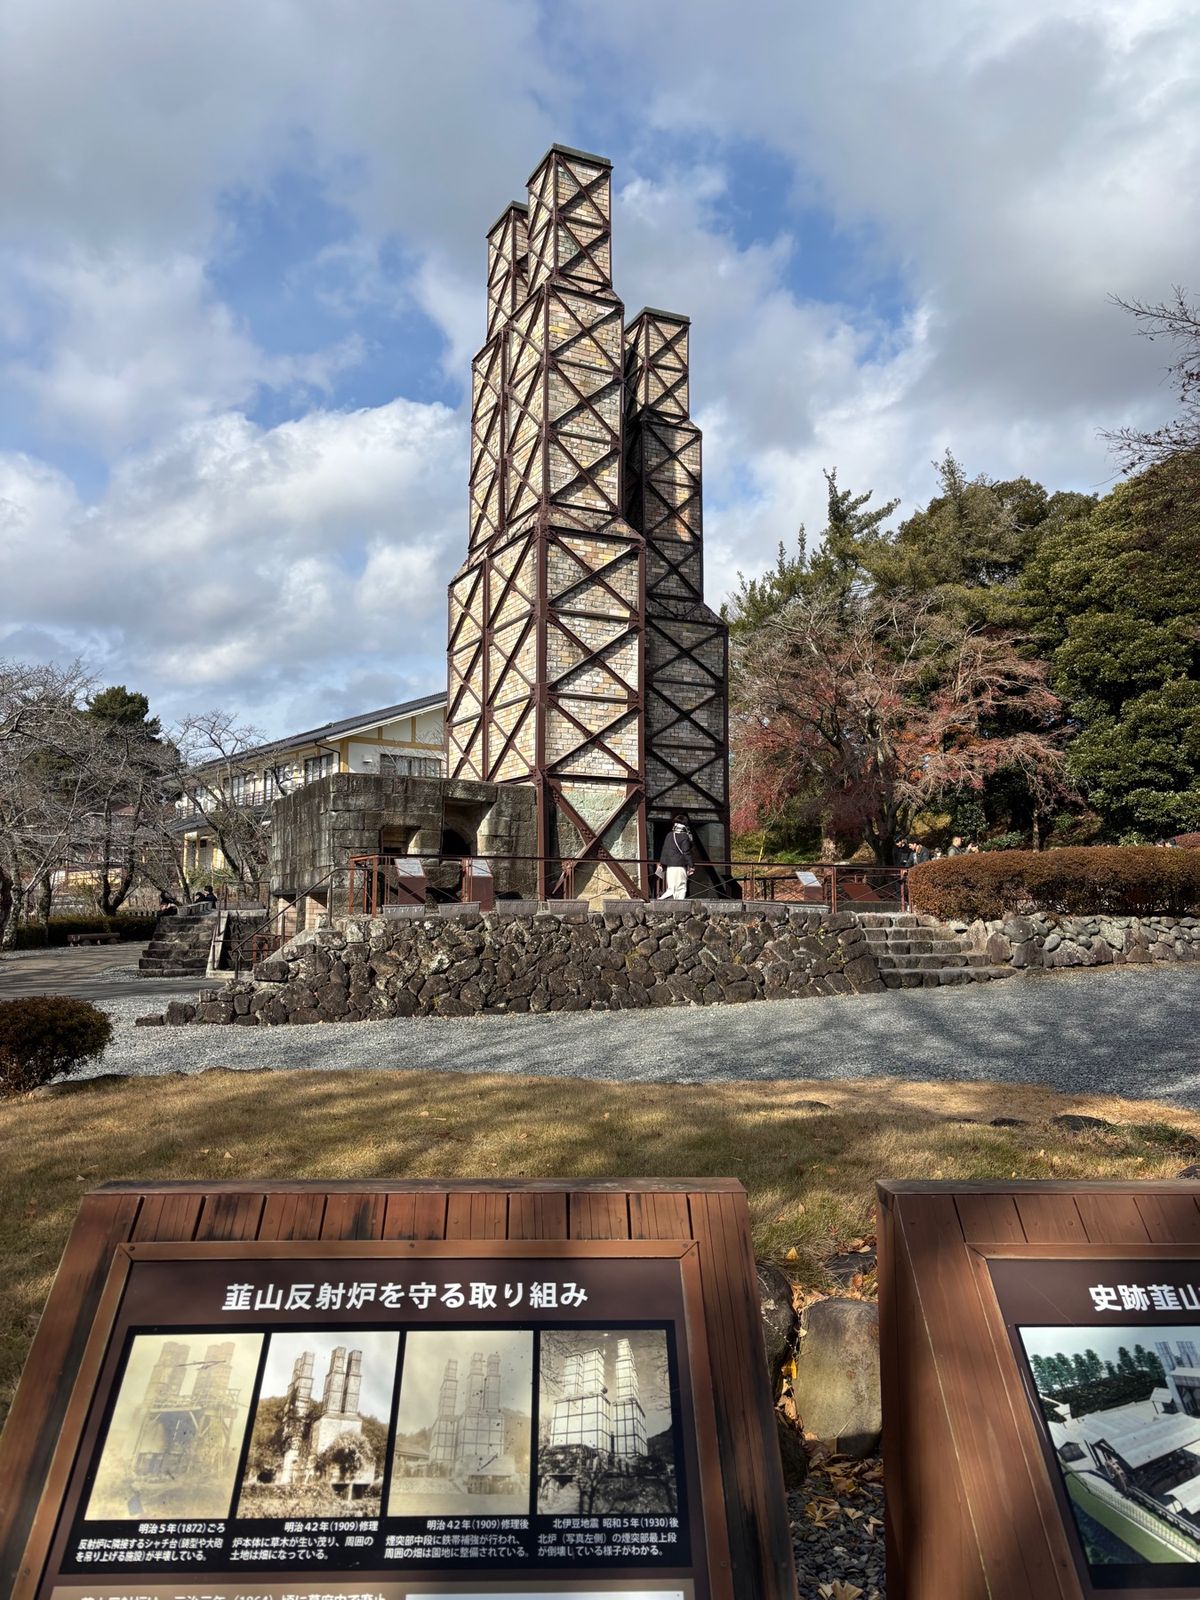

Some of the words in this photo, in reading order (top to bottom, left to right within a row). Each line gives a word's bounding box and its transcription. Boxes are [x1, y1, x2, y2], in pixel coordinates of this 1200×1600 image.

[222, 1282, 588, 1310] 韮山反射炉を守る取り組み
[1089, 1284, 1200, 1311] 史跡韮山
